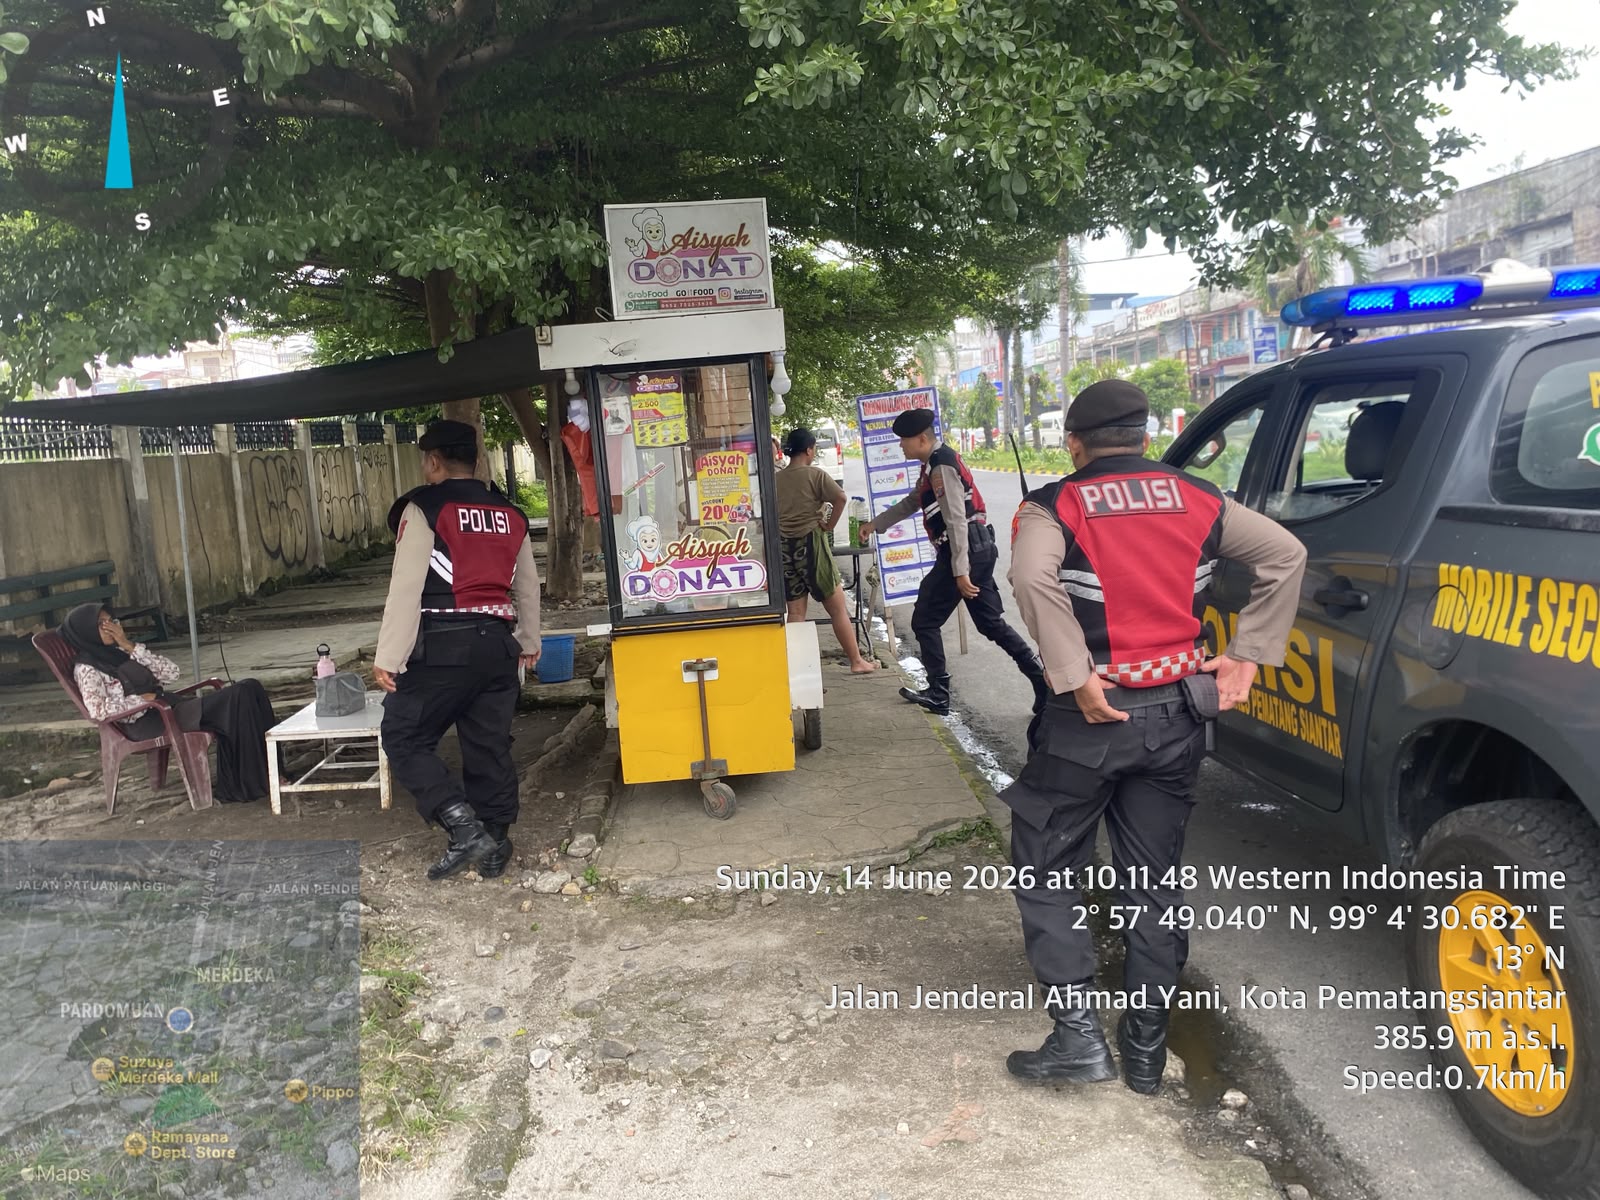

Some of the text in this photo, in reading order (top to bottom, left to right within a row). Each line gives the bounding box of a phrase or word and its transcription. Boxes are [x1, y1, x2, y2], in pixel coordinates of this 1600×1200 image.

[660, 223, 751, 267] Aisyah
[634, 257, 752, 283] DONAT
[628, 289, 668, 298] GrabFood
[638, 400, 658, 408] 2.500
[912, 392, 933, 410] CELL
[701, 453, 745, 468] Aisyah
[707, 467, 739, 476] DONAT
[1079, 478, 1184, 513] POLISI
[458, 508, 510, 534] POLISI
[703, 505, 737, 520] 20%
[655, 528, 751, 579] Aisyah
[628, 565, 752, 597] DONAT
[1432, 562, 1532, 647] MOBILE
[1251, 688, 1342, 760] PEMATANG SIANTAR
